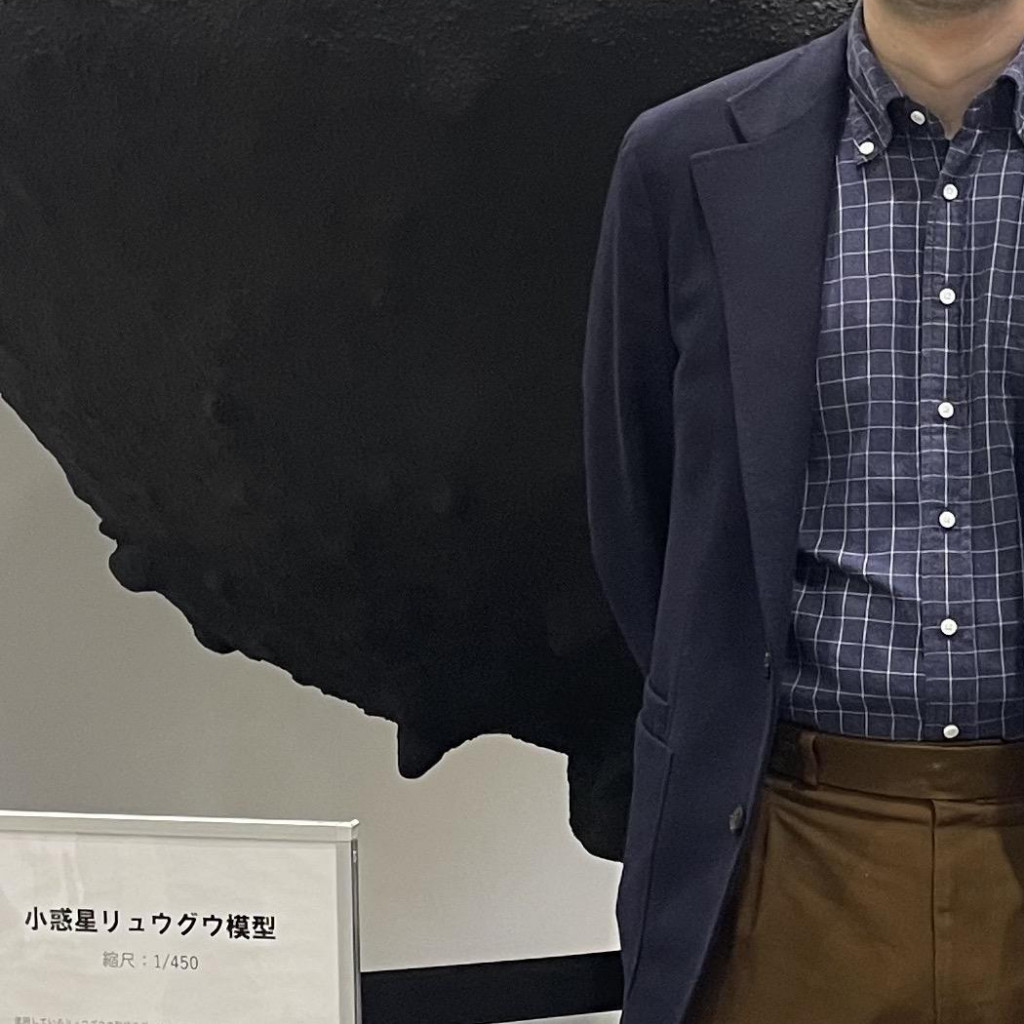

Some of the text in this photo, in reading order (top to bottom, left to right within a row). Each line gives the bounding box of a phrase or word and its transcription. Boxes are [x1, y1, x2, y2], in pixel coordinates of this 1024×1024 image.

[25, 906, 276, 940] 小惑星リュウグウ模型
